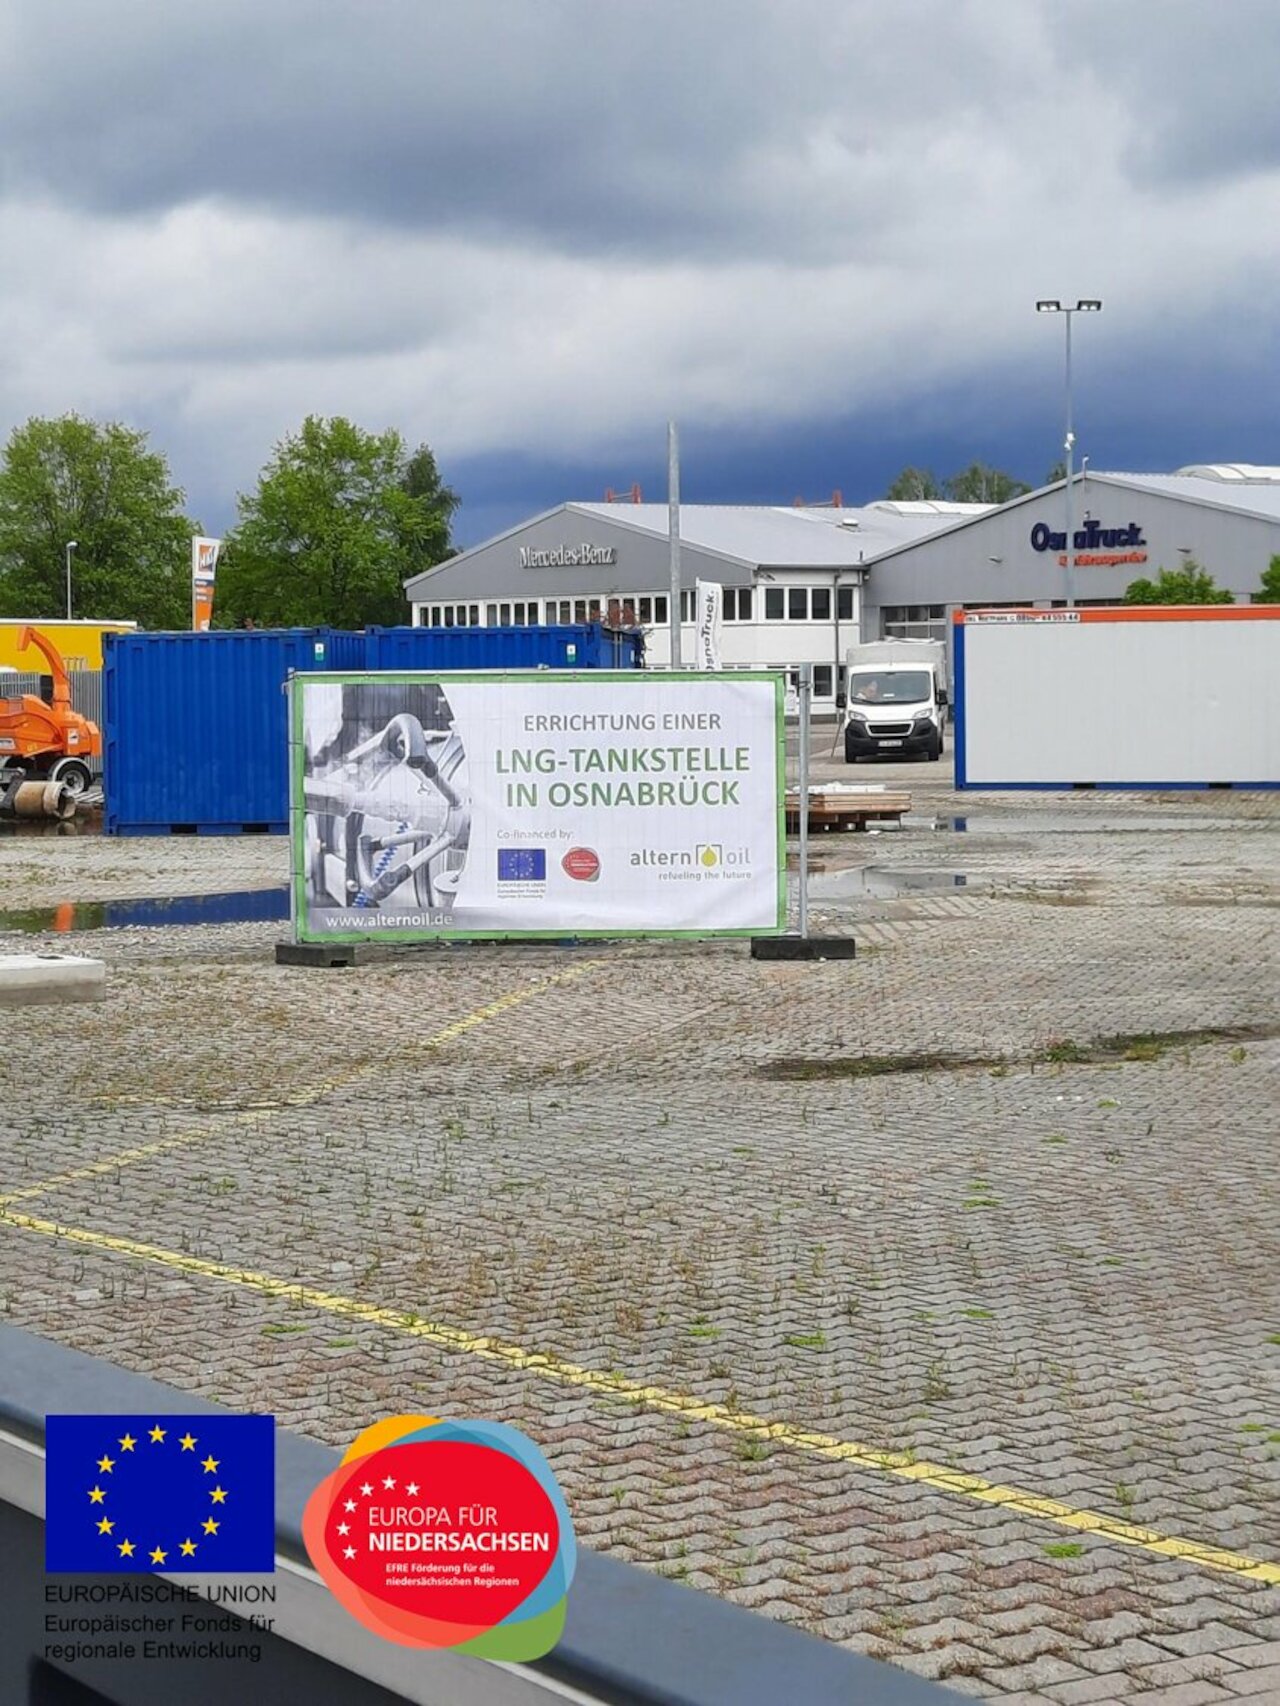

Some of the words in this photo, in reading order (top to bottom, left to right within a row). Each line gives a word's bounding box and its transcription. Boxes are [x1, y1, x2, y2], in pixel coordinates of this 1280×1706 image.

[519, 543, 614, 567] Mercedes-Benz
[524, 714, 656, 731] ERRICHTUNG
[663, 713, 722, 730] EINER
[496, 747, 750, 773] LNG-TANKSTELLE
[507, 783, 538, 807] IN
[548, 775, 740, 807] OSNABRÜCK
[497, 829, 556, 841] Co-financed
[630, 849, 691, 866] altern
[726, 847, 751, 865] oil
[658, 870, 701, 882] refueling
[704, 870, 719, 880] the
[722, 870, 752, 880] future
[325, 912, 453, 928] www.alternoil.de
